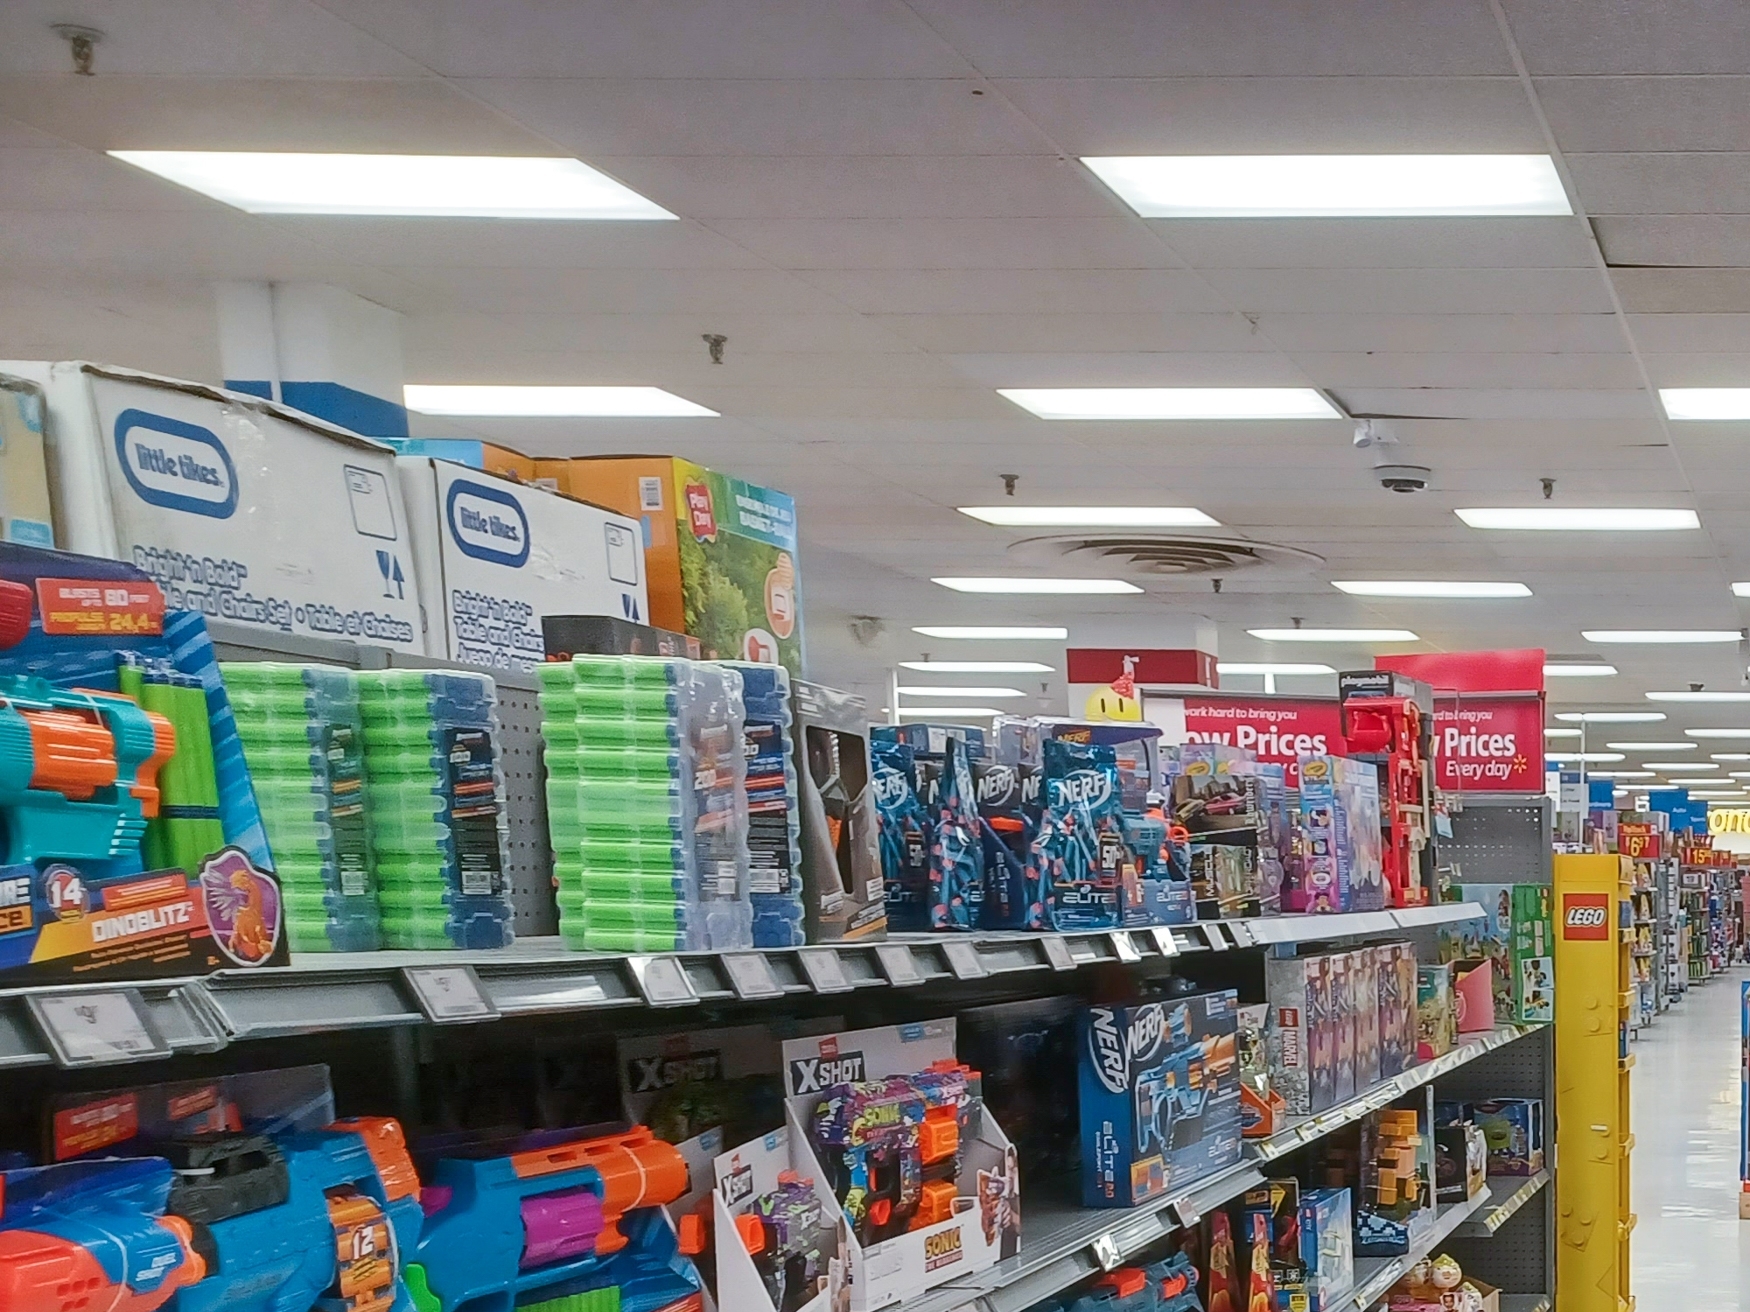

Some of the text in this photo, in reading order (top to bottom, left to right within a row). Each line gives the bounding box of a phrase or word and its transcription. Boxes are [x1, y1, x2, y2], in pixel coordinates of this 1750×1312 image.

[134, 442, 221, 485] little tikes
[459, 505, 517, 541] little tikes
[133, 545, 184, 582] Bright
[304, 603, 342, 632] Table
[361, 612, 413, 642] Chaises
[453, 614, 487, 642] Table
[1208, 705, 1233, 719] hard
[1235, 707, 1246, 719] to
[1248, 706, 1273, 723] bring
[1275, 709, 1297, 723] you
[1236, 724, 1327, 757] Prices
[1441, 727, 1516, 758] Prices
[977, 768, 1016, 804] NERF
[1446, 759, 1511, 780] Every day
[1058, 771, 1105, 807] NERF
[52, 877, 83, 907] 14
[91, 903, 190, 943] DINOBLITZ
[1566, 907, 1606, 927] LEGO
[1089, 1007, 1127, 1092] NERF
[1127, 1008, 1164, 1055] NERF
[924, 1227, 962, 1259] SONIC
